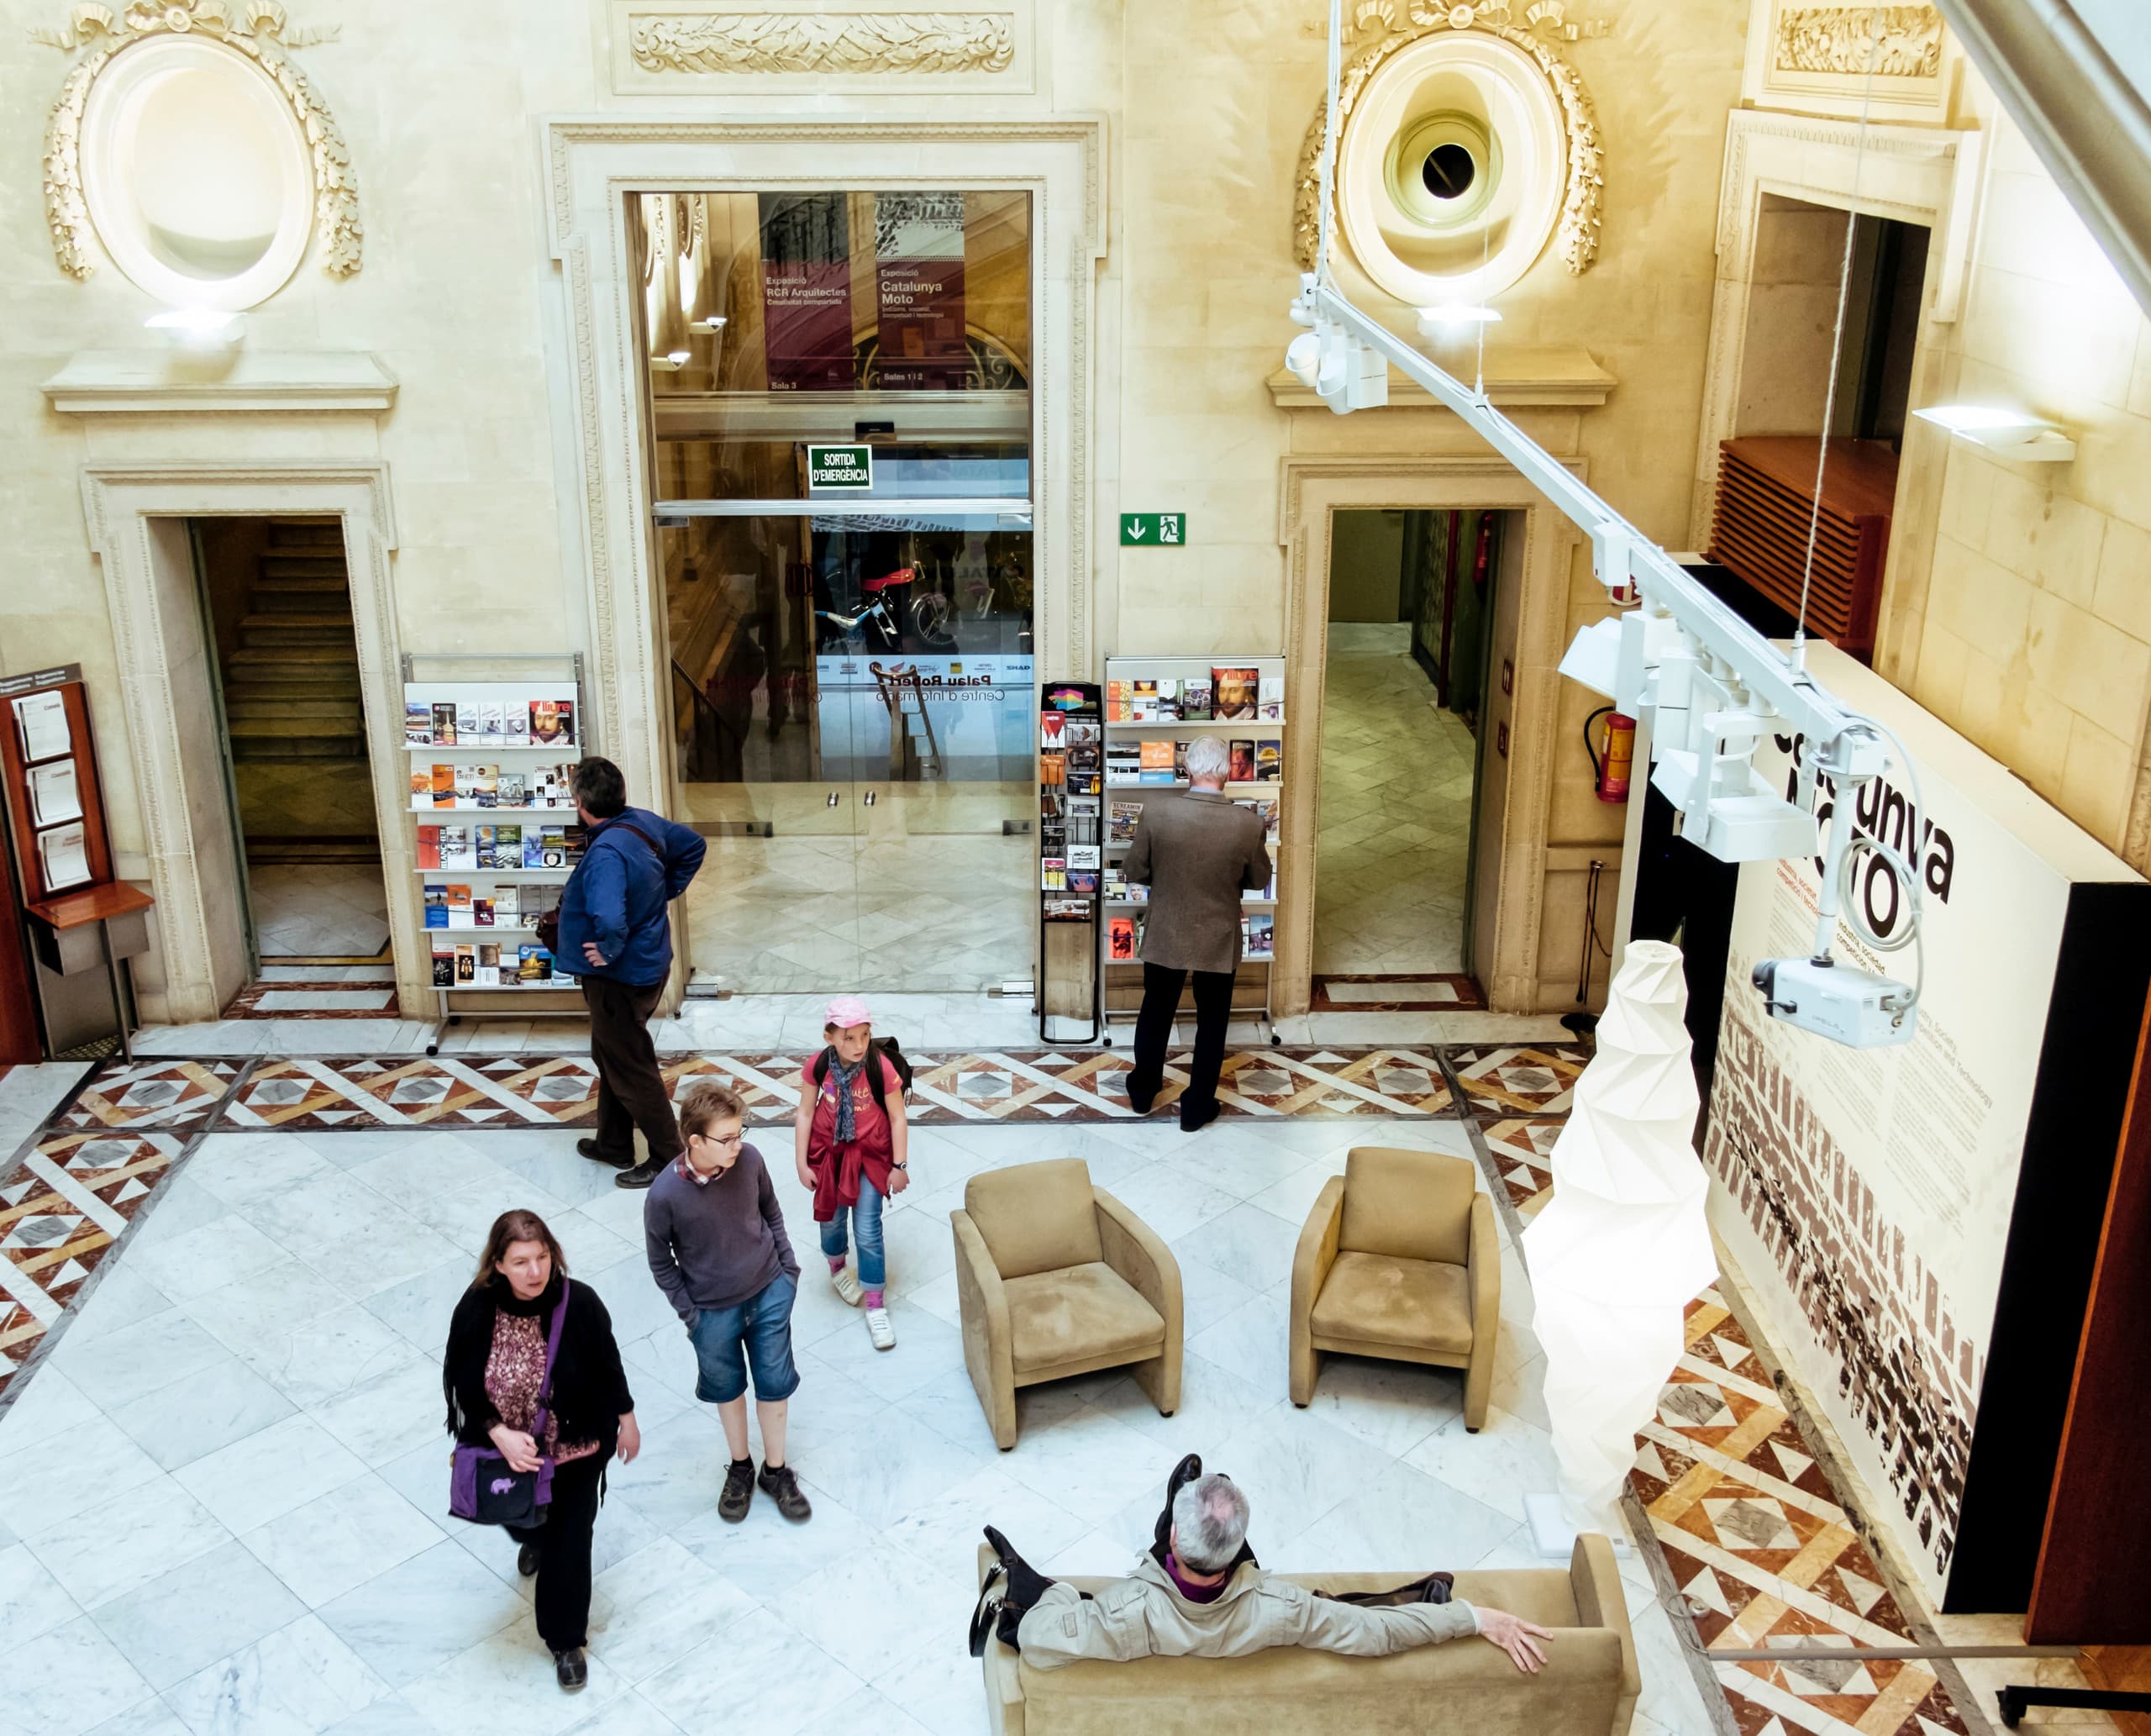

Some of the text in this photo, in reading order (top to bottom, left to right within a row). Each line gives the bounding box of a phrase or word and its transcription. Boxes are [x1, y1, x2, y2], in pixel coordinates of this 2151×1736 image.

[881, 269, 918, 277] Exposició
[766, 276, 807, 286] Exposició
[881, 281, 942, 293] Catalunya
[766, 288, 846, 298] RCR Arquitectes
[881, 293, 913, 304] Moto
[884, 372, 906, 381] Sales
[771, 381, 797, 390] Sala 3
[823, 453, 856, 466] SORTIDA
[813, 466, 868, 482] D'EMERGÈNCIA
